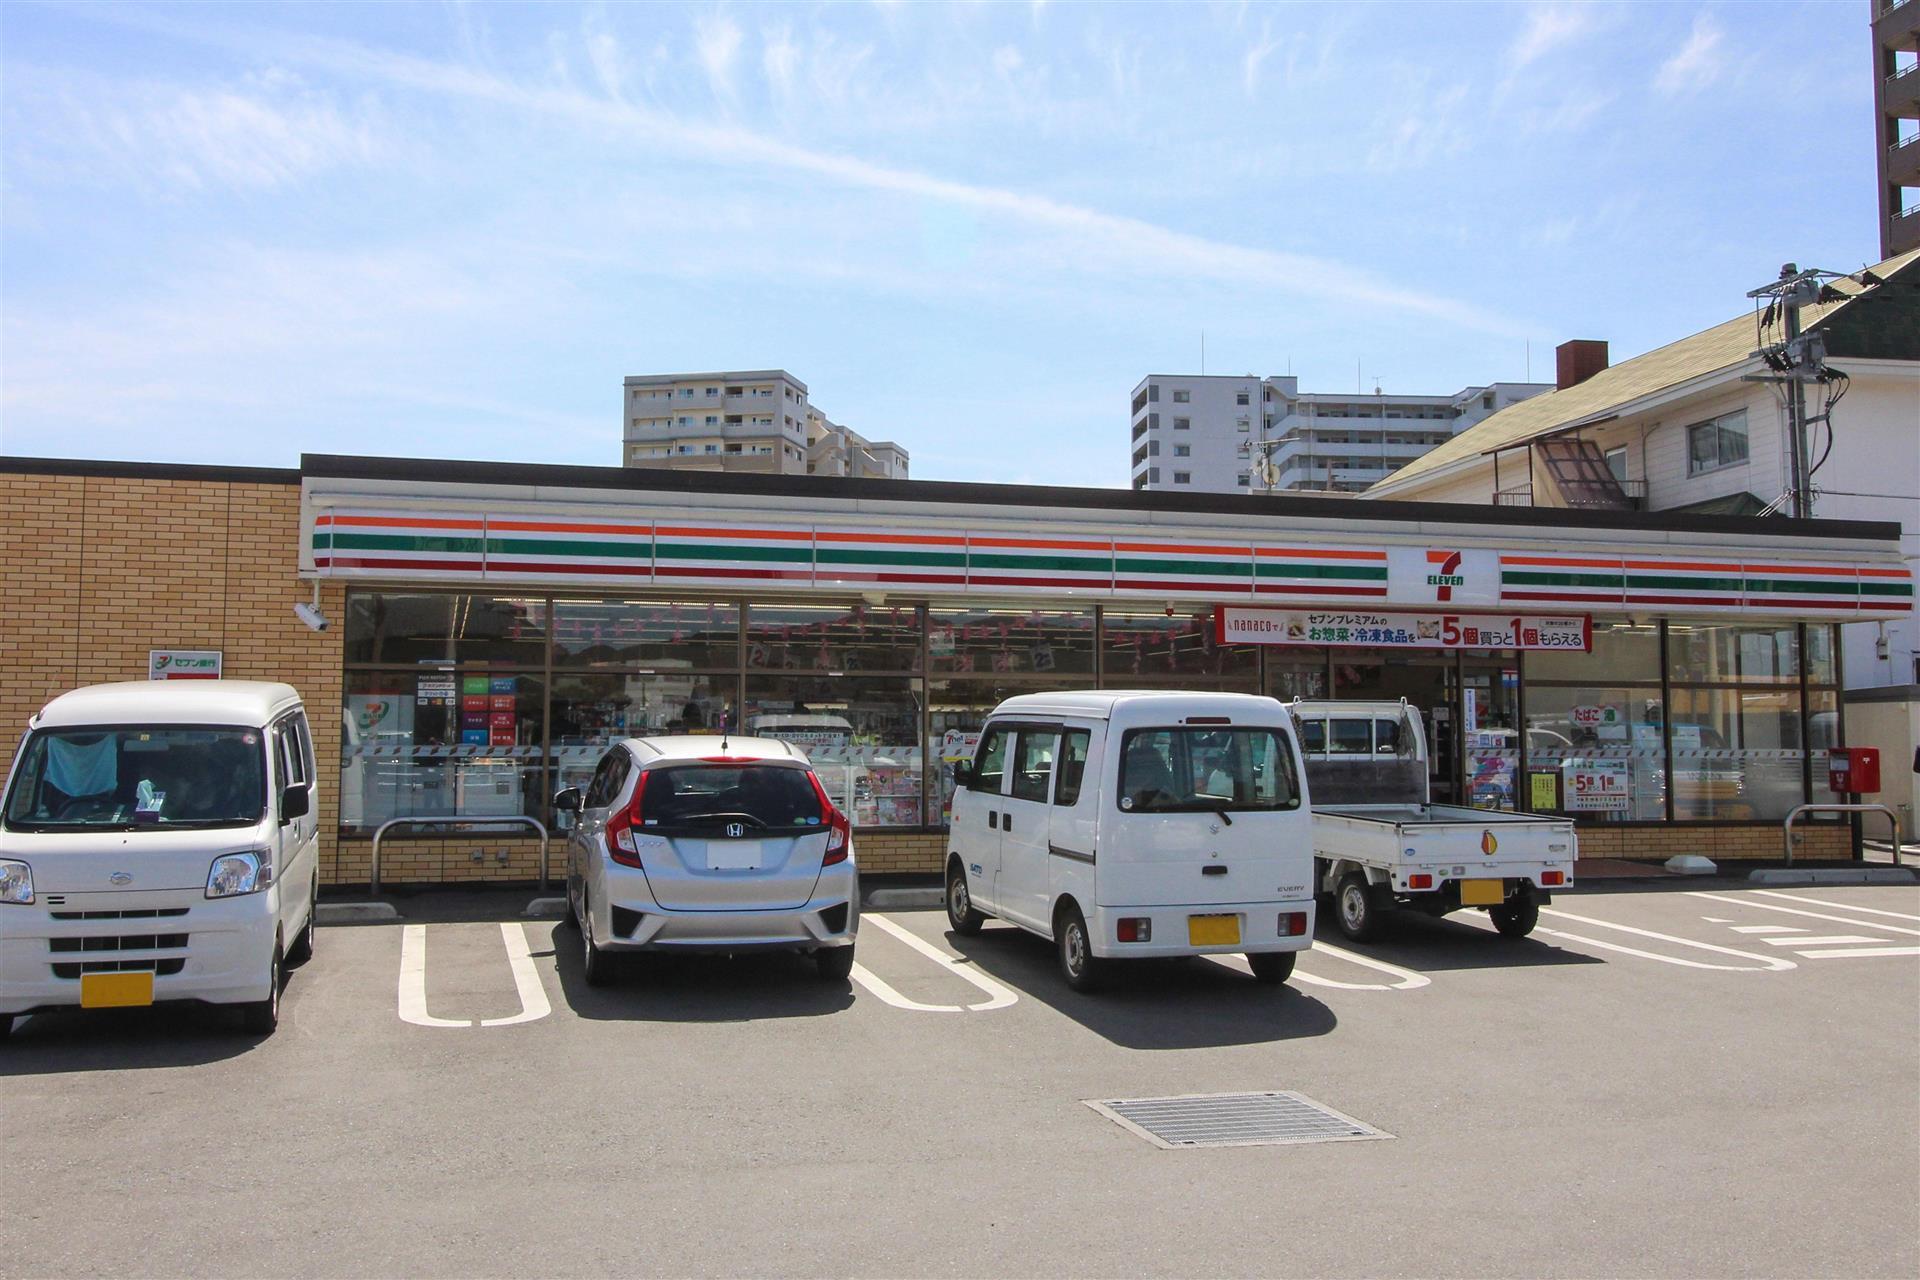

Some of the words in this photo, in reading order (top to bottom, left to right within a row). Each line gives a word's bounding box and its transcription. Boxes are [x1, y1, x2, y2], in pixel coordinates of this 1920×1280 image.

[1308, 614, 1388, 626] セブンプレミアムの
[1574, 708, 1600, 722] たばこ
